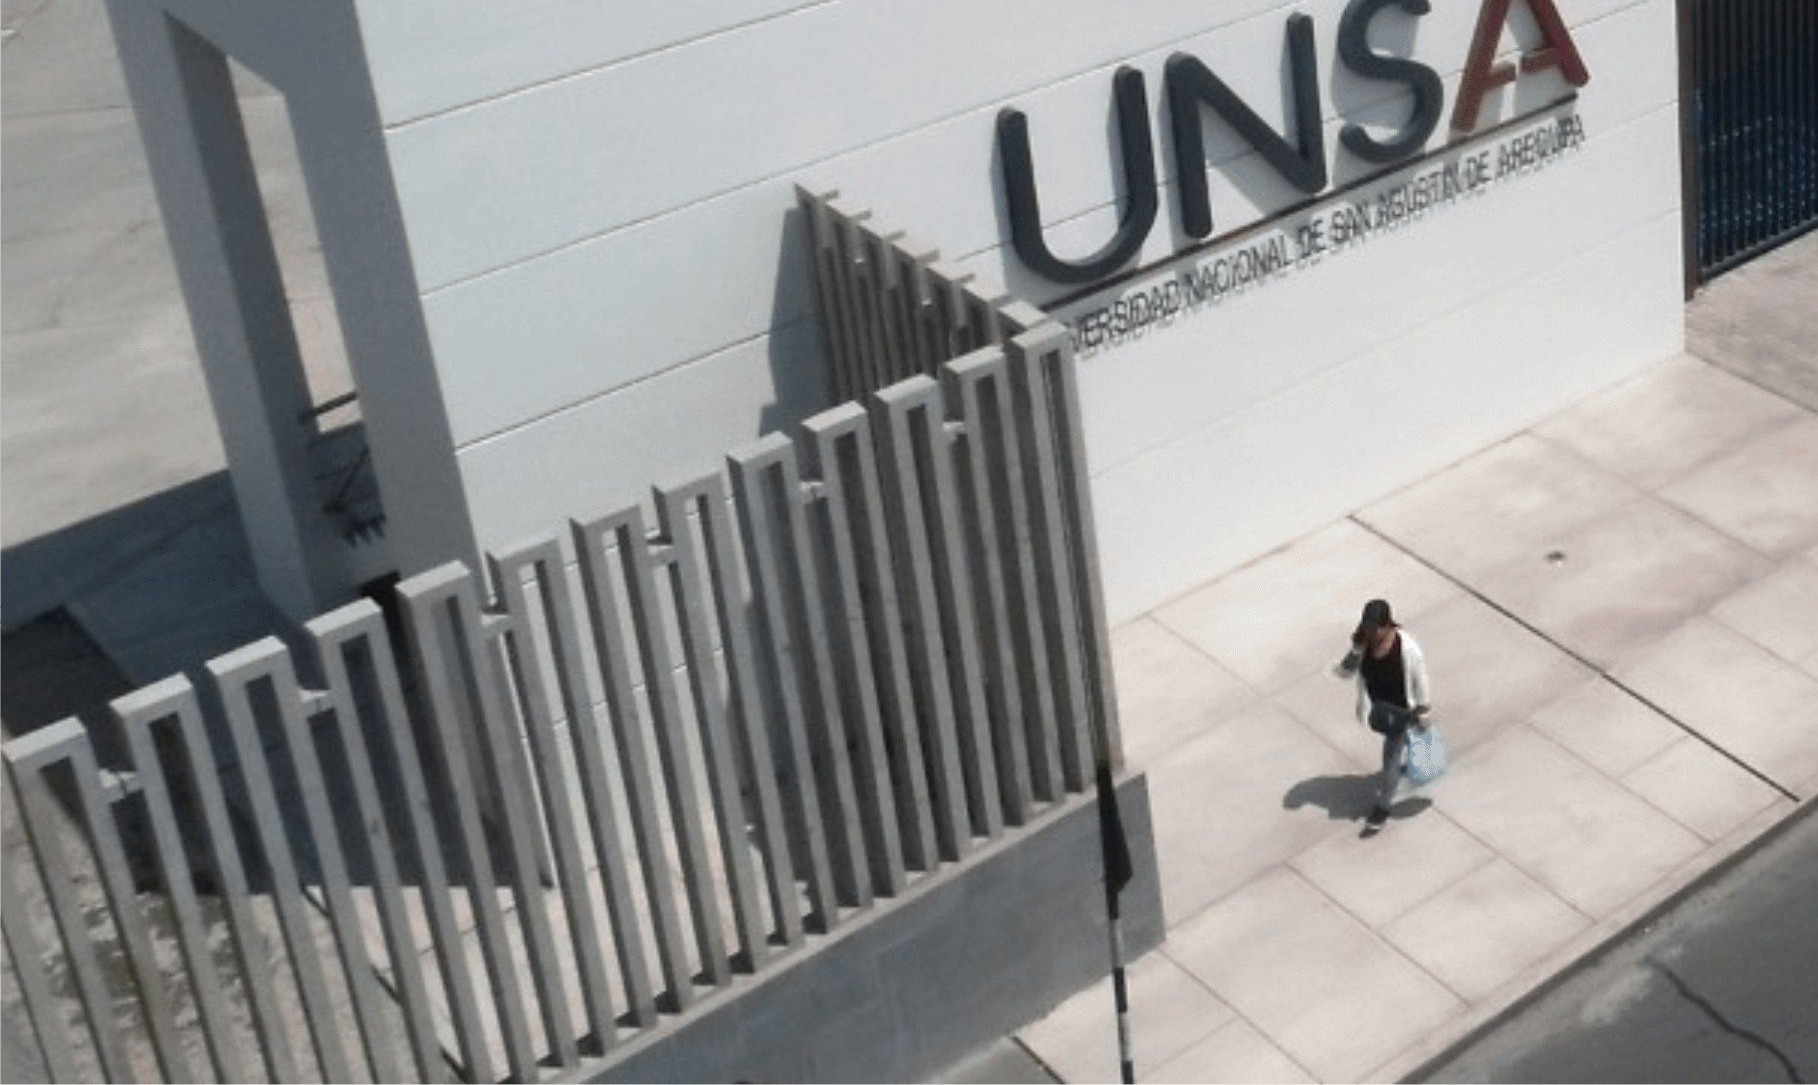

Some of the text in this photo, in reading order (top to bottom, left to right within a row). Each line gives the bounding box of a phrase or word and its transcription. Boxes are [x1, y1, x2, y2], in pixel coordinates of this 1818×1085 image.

[1185, 235, 1290, 305] NACIONAL
[1297, 219, 1325, 259] DE
[1330, 202, 1371, 245] SAN
[1466, 151, 1491, 189] DE
